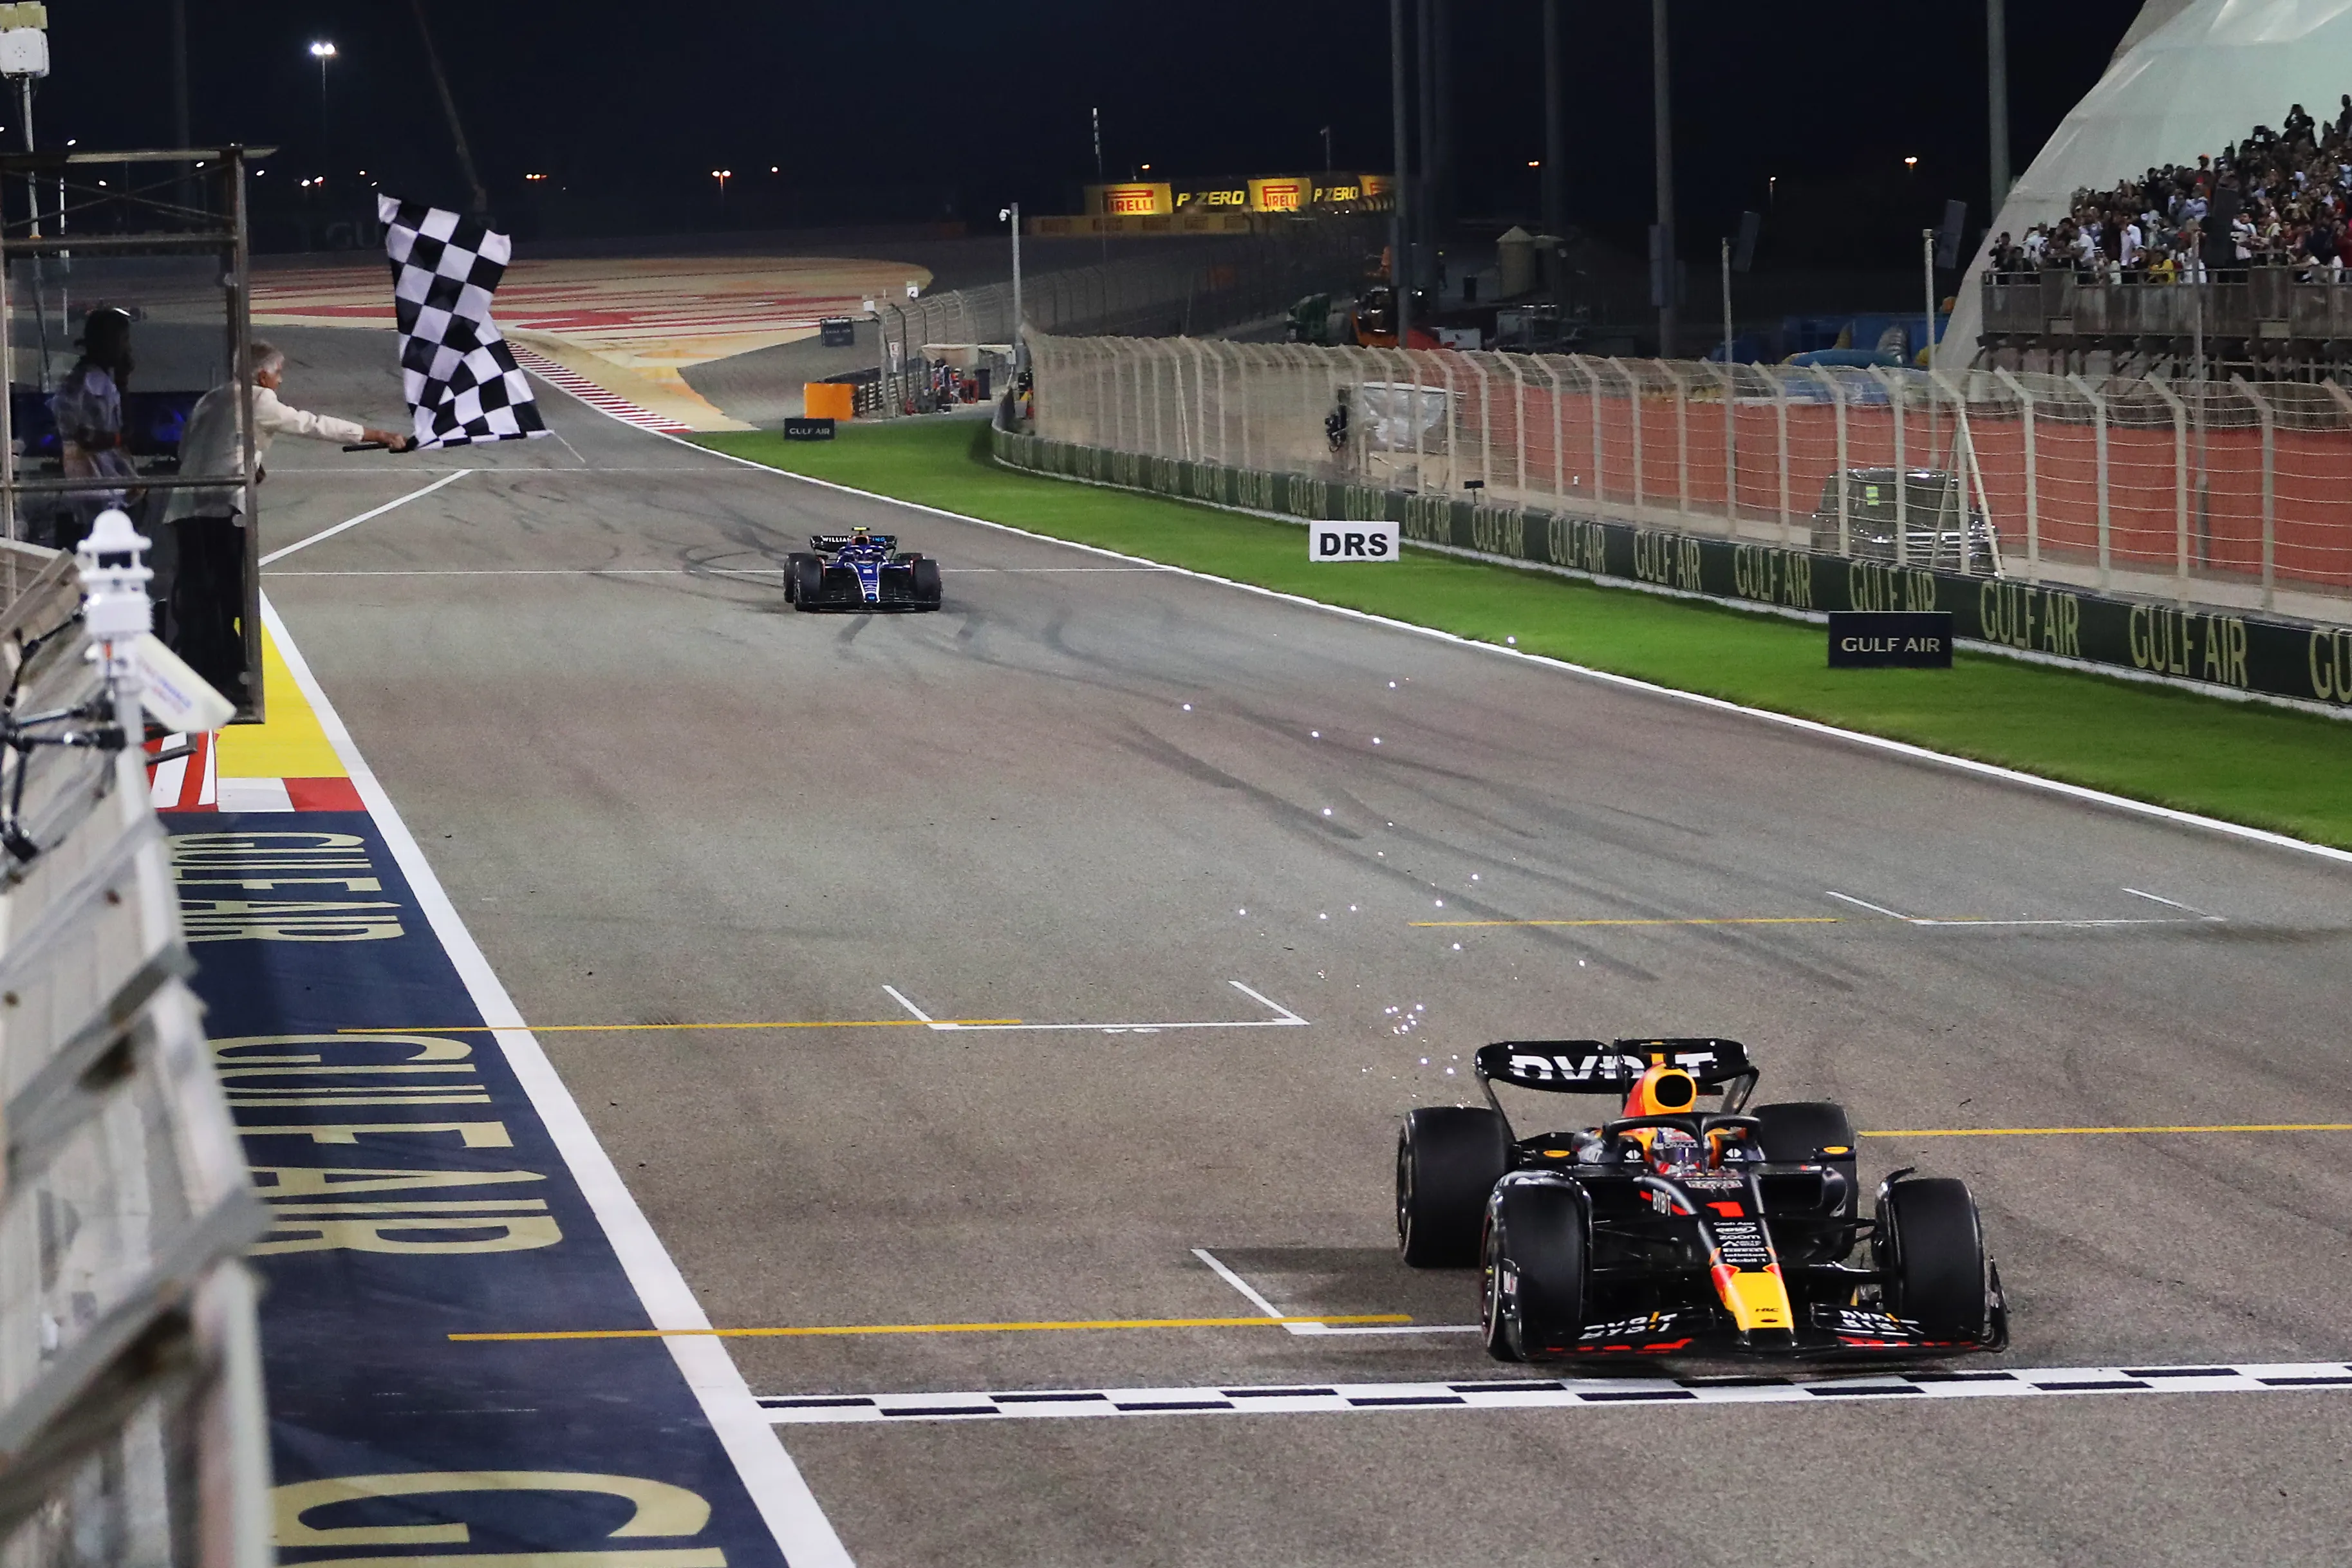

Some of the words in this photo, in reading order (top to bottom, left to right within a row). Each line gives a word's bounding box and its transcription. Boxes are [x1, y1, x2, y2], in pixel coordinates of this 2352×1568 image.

[1105, 189, 1154, 212] PIRELLI
[1176, 193, 1191, 207] P
[1195, 191, 1245, 205] ZERO
[1262, 185, 1299, 207] PIRELLI
[1313, 188, 1323, 202] P
[1324, 186, 1359, 201] ZERO
[1320, 532, 1388, 557] DRS
[1548, 515, 1581, 568] GULF
[1583, 521, 1606, 574] AIR
[1634, 528, 1674, 585] GULF
[1676, 534, 1702, 591] AIR
[1734, 544, 1780, 602] GULF
[1783, 550, 1813, 609] AIR
[1849, 559, 1901, 611] GULF
[1905, 567, 1936, 611] AIR
[1979, 579, 2038, 649] GULF
[2042, 587, 2080, 656] AIR
[1841, 637, 1900, 653] GULF
[1903, 637, 1941, 653] AIR
[2129, 604, 2197, 675] GULF
[2203, 614, 2248, 688] AIR
[169, 832, 382, 892] GULF
[181, 899, 405, 942] AIR
[207, 1034, 514, 1148] GULF
[247, 1166, 563, 1256] AIR
[1706, 1201, 1745, 1218] 1
